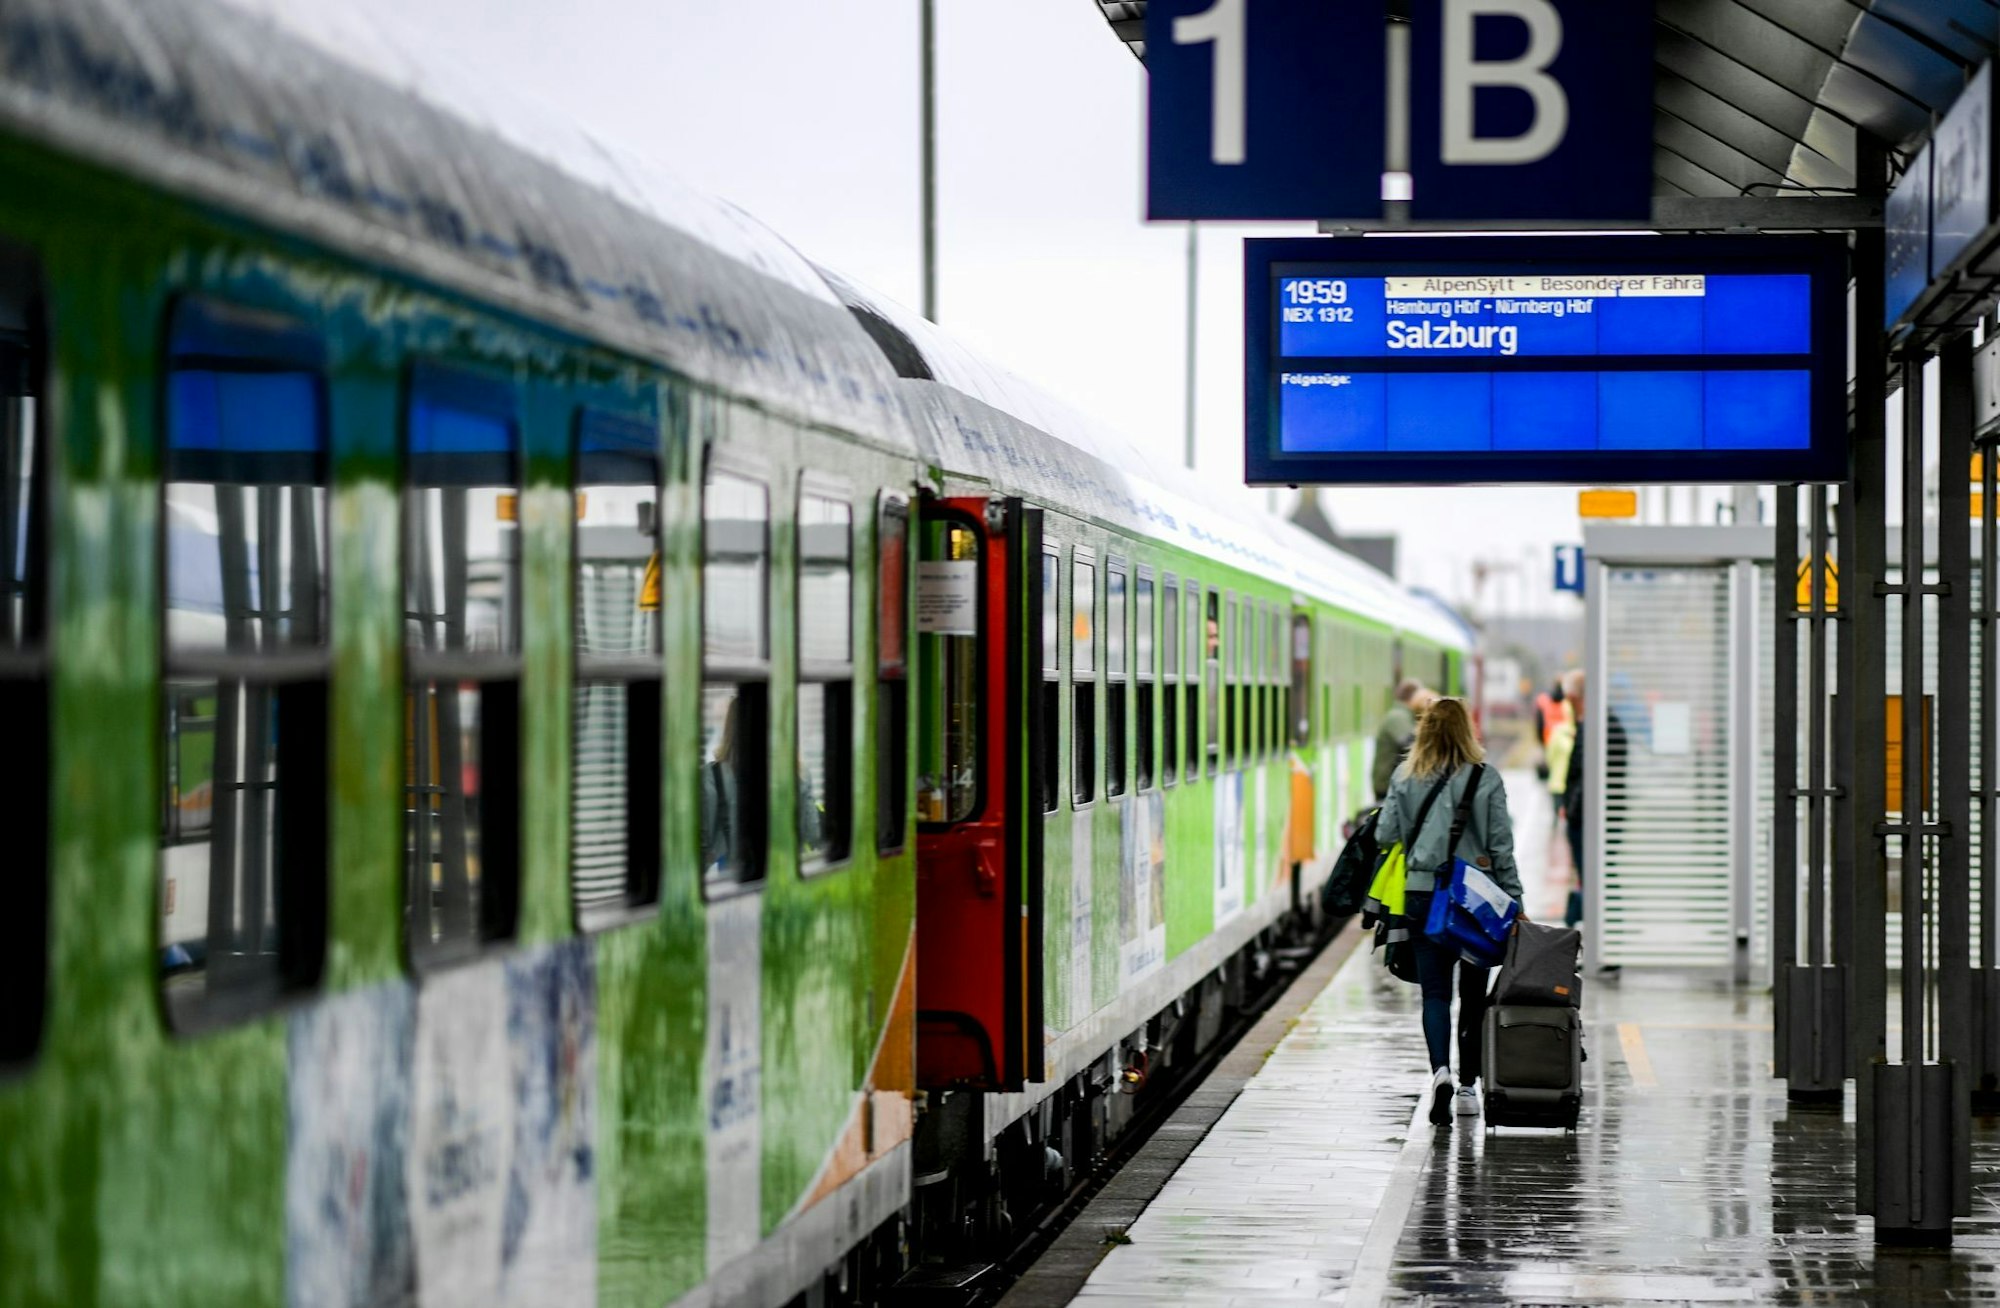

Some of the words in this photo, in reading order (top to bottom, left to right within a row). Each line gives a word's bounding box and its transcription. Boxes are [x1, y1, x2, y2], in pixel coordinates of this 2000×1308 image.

[1173, 0, 1246, 165] 1
[1440, 0, 1570, 165] B
[1284, 279, 1348, 304] 19:59
[1423, 278, 1515, 295] AlpenSylt
[1541, 277, 1645, 291] Besonderer
[1283, 307, 1314, 323] NEX
[1317, 307, 1354, 323] 1312
[1386, 299, 1452, 318] Hamburg
[1454, 299, 1481, 314] Hbf
[1495, 298, 1564, 317] Nürnberg
[1566, 298, 1594, 314] Hbf
[1386, 320, 1517, 355] Salzburg
[1281, 372, 1351, 387] Folgezüge:
[1556, 545, 1577, 585] 1
